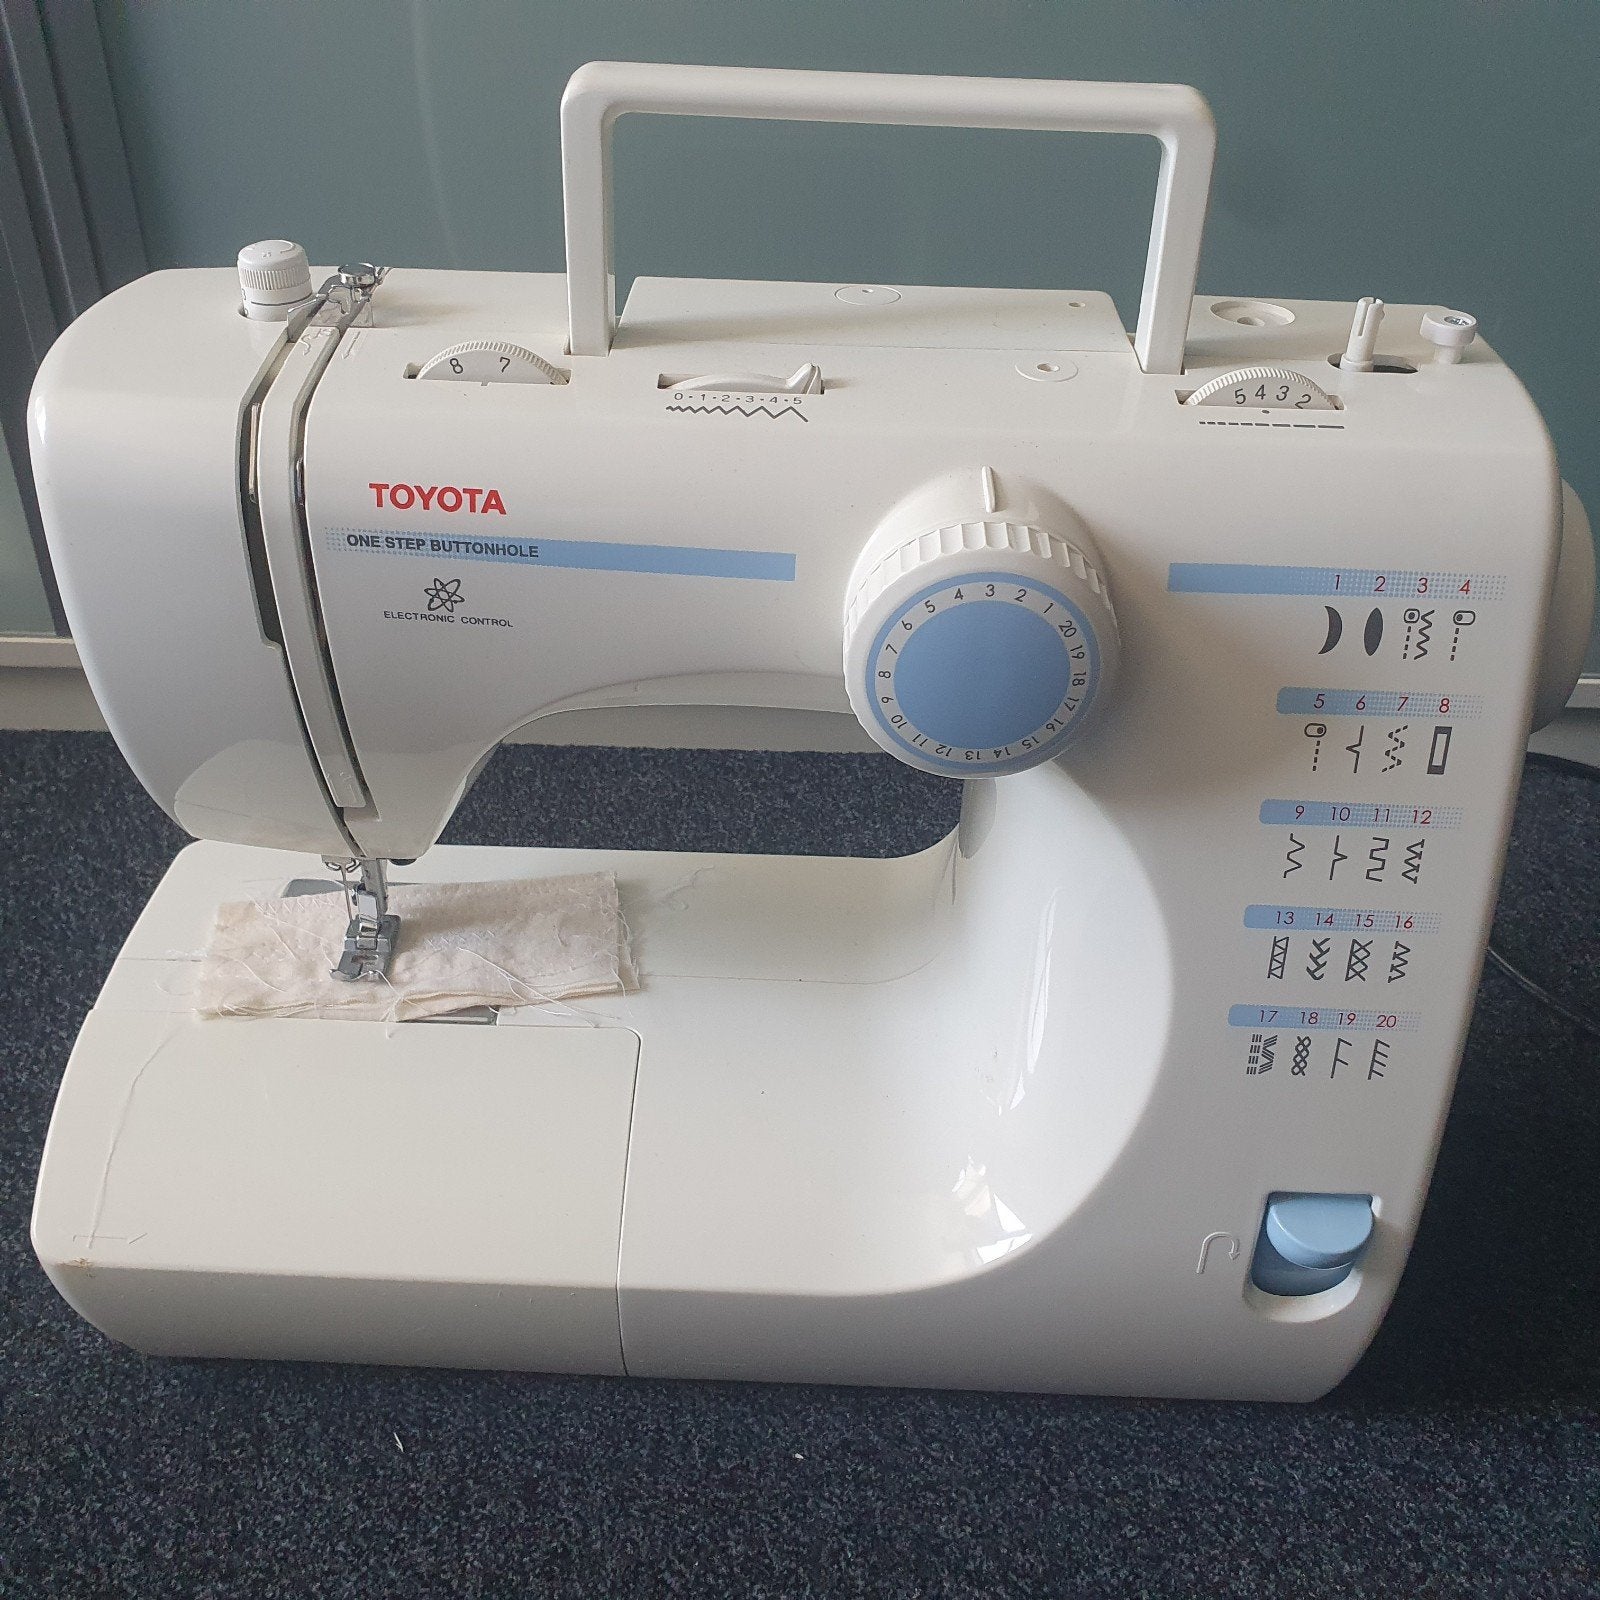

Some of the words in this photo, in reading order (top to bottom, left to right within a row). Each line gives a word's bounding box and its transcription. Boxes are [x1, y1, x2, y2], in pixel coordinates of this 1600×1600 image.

[449, 358, 464, 374] 8
[499, 357, 511, 373] 7
[1234, 388, 1247, 405] 5
[1254, 384, 1266, 400] 4
[1275, 385, 1290, 401] 3
[1294, 393, 1312, 410] 2
[369, 483, 507, 515] TOYOTA
[346, 534, 381, 549] ONE
[385, 536, 426, 552] STEP
[430, 539, 539, 558] BUTTONHOLE
[985, 584, 995, 597] 3
[1335, 575, 1341, 590] 1
[1374, 576, 1386, 592] 2
[1417, 578, 1429, 593] 3
[1459, 579, 1471, 594] 4
[954, 588, 964, 600] 4
[1014, 588, 1027, 602] 2
[924, 600, 936, 613] 5
[1042, 602, 1054, 614] 1
[383, 610, 455, 623] ELECTRONIC
[460, 615, 514, 627] CONTROL
[901, 620, 912, 630] 6
[1058, 620, 1078, 638] 20
[886, 644, 898, 654] 7
[1070, 645, 1086, 660] 19
[878, 670, 892, 678] 8
[1072, 671, 1086, 686] 18
[881, 696, 894, 704] 9
[1064, 696, 1080, 712] 17
[1313, 693, 1325, 709] 5
[1356, 695, 1366, 710] 6
[1396, 697, 1409, 711] 7
[1439, 698, 1450, 713] 8
[891, 714, 908, 729] 10
[1046, 718, 1064, 732] 16
[912, 734, 929, 747] 11
[1021, 736, 1040, 750] 15
[935, 743, 952, 757] 12
[965, 750, 981, 760] 13
[993, 748, 1011, 758] 14
[1295, 805, 1305, 819] 9
[1331, 806, 1351, 821] 10
[1372, 808, 1391, 822] 11
[1412, 809, 1432, 824] 12
[1276, 911, 1295, 925] 13
[1315, 913, 1334, 926] 14
[1355, 914, 1375, 928] 15
[1395, 915, 1414, 929] 16
[1259, 1010, 1278, 1023] 17
[1301, 1011, 1319, 1024] 18
[1338, 1012, 1356, 1025] 19
[1376, 1014, 1398, 1028] 20
